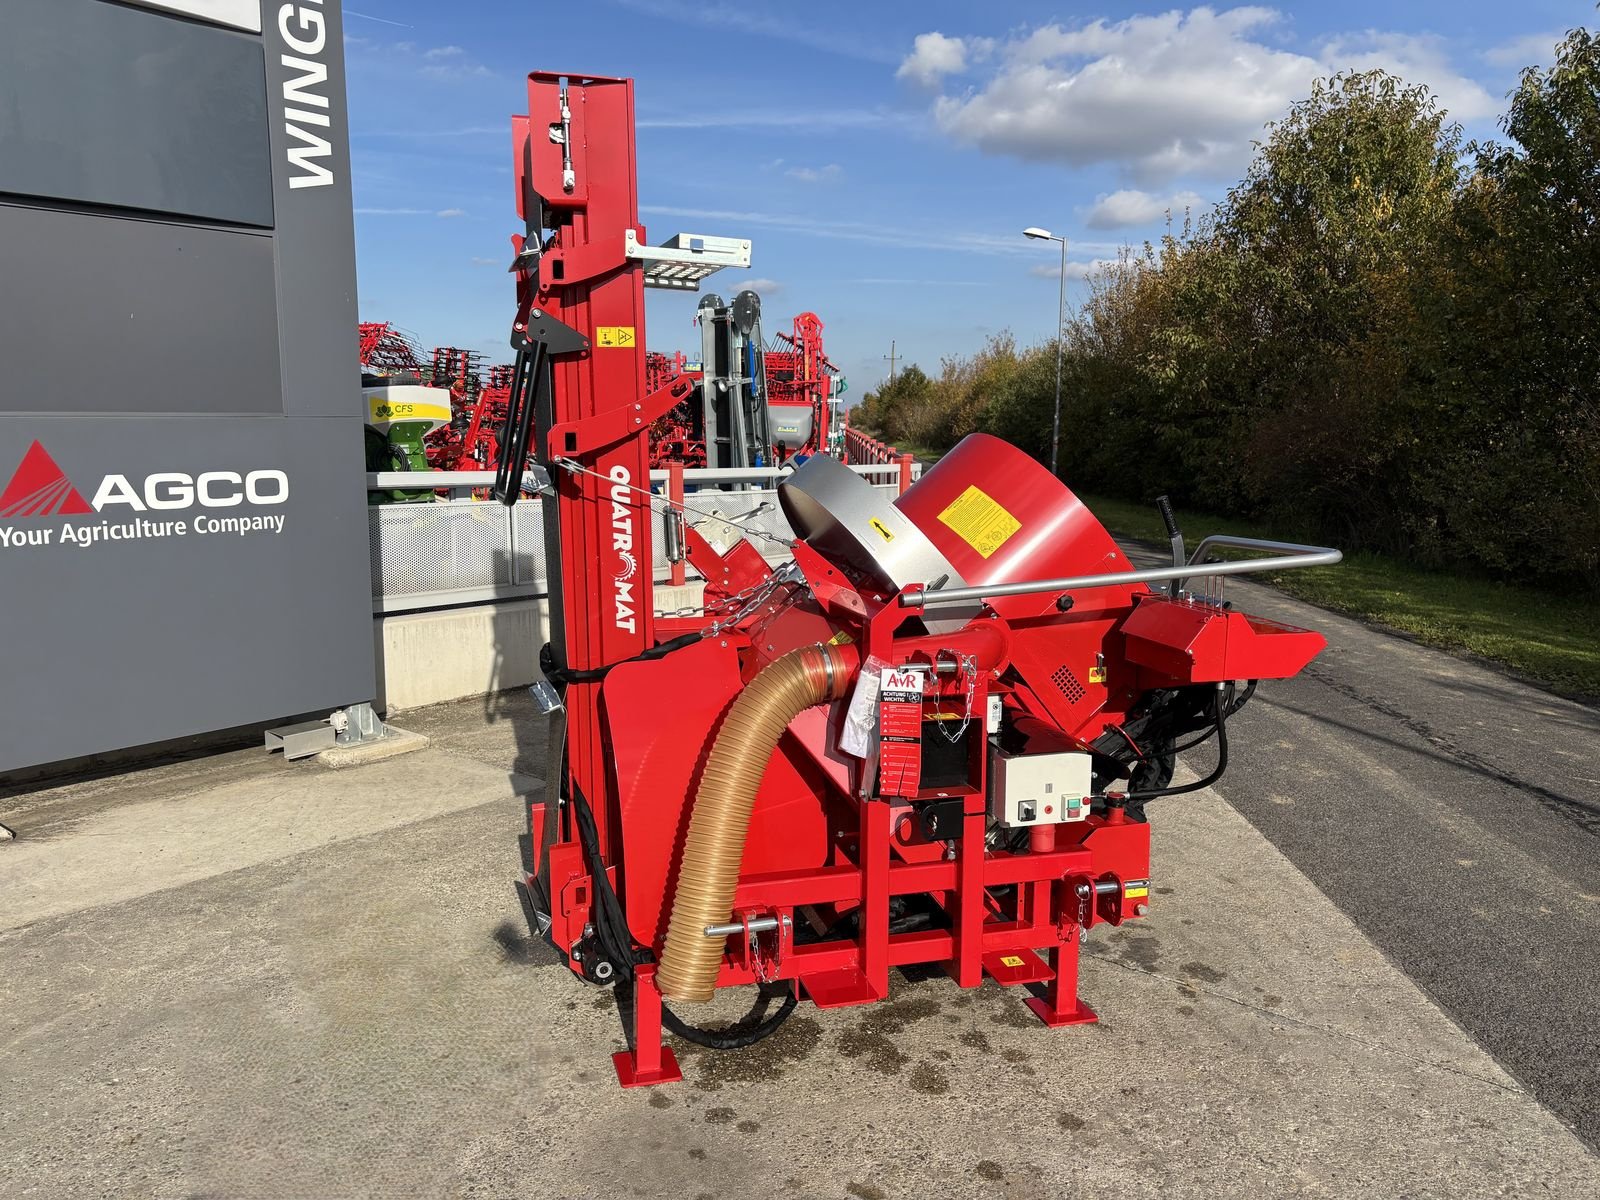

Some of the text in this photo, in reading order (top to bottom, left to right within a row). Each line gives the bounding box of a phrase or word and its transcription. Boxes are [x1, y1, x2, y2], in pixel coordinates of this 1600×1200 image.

[278, 0, 334, 189] WING
[395, 404, 413, 413] CFS
[91, 469, 289, 512] AGCO
[0, 514, 285, 547] Your Agriculture Company
